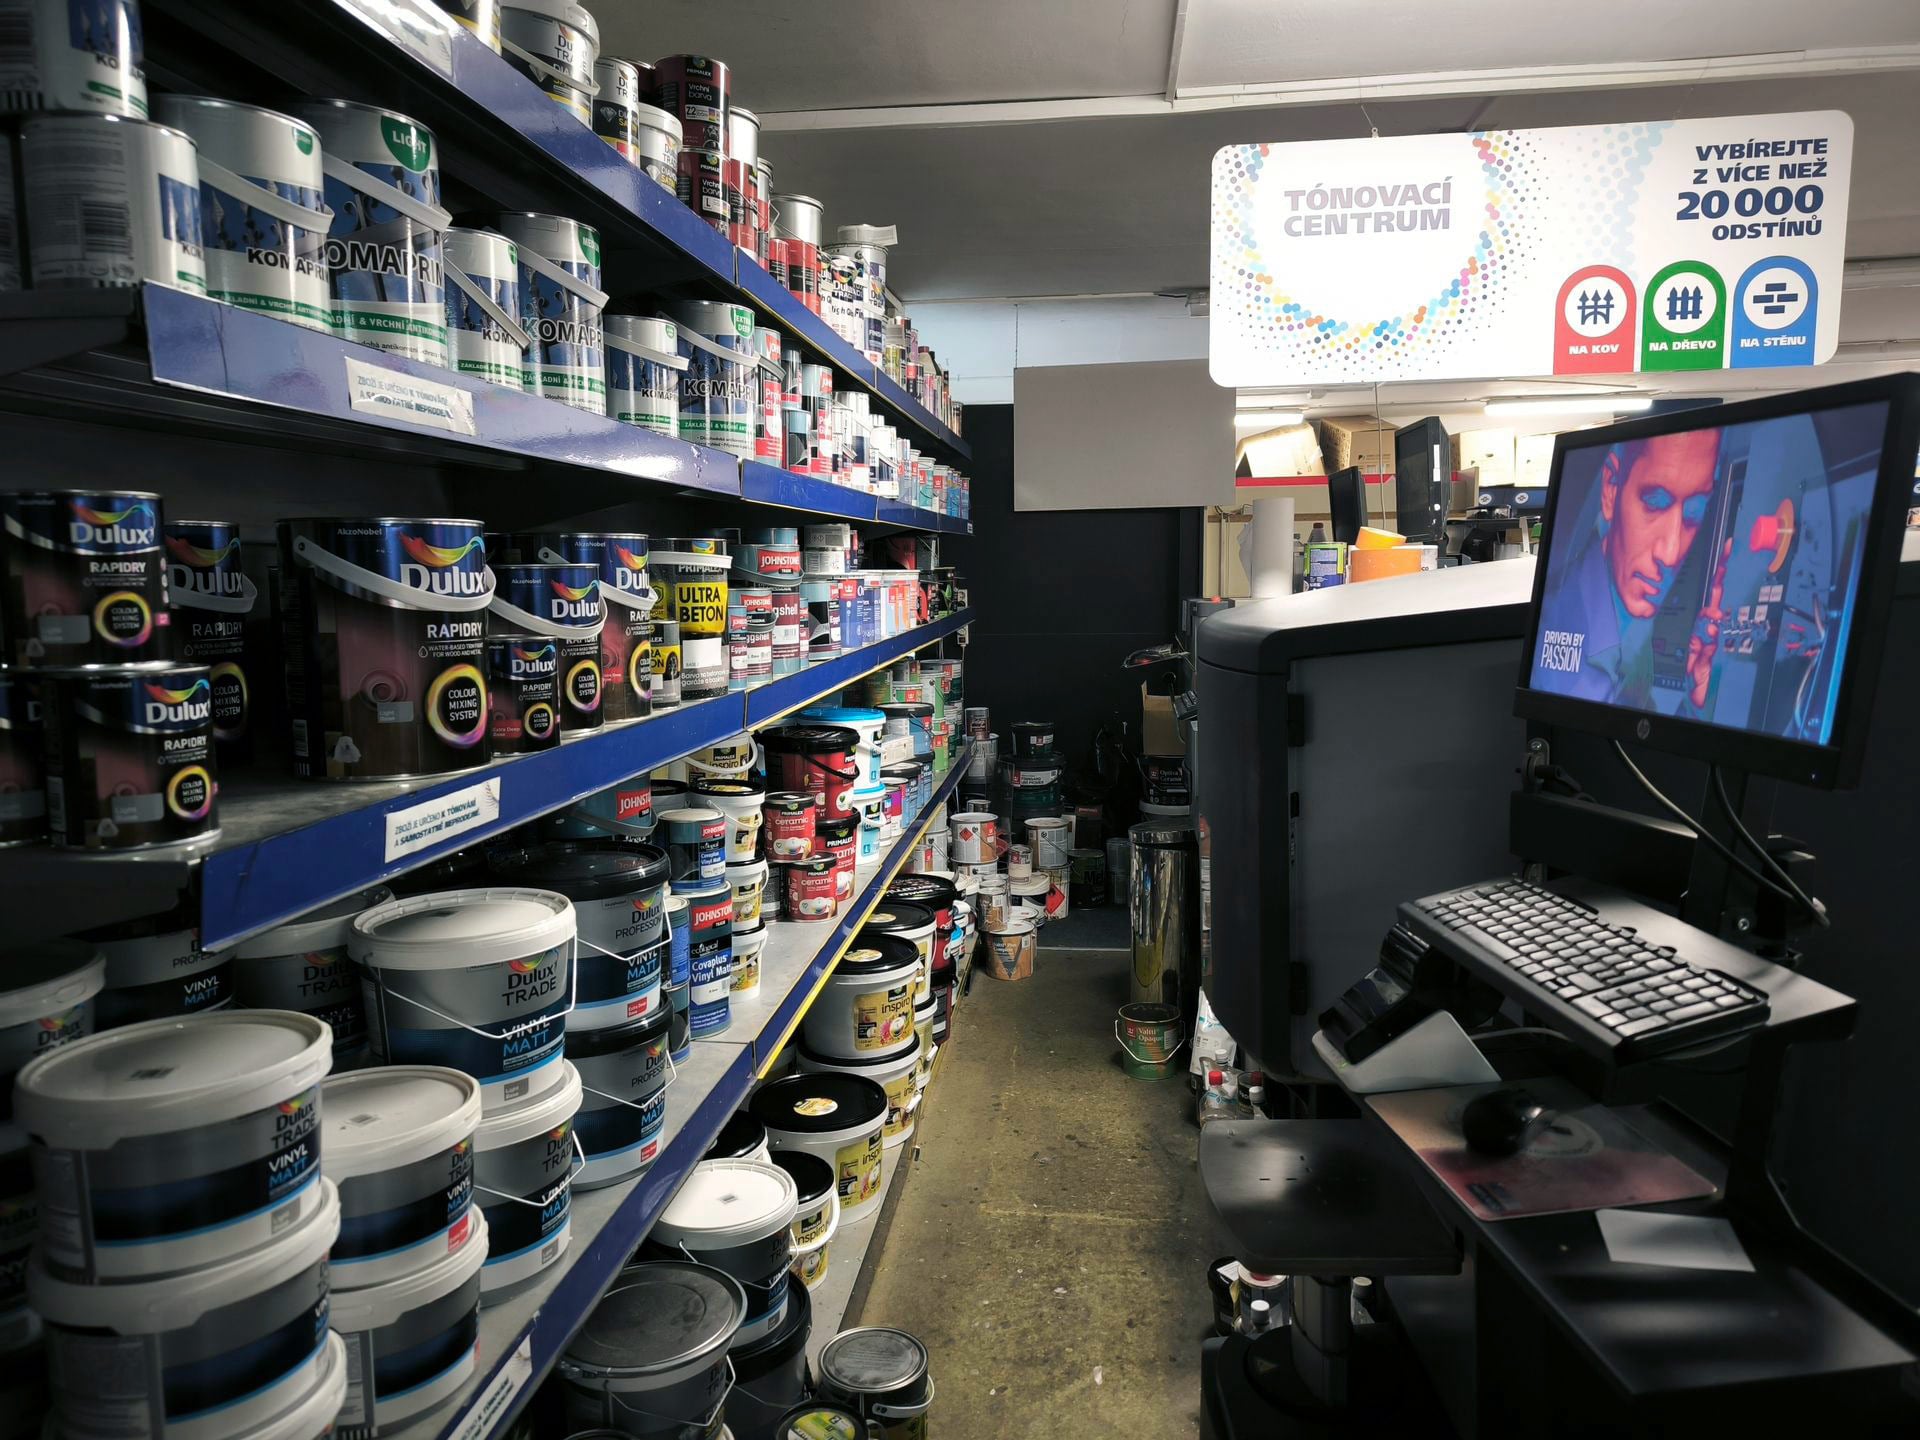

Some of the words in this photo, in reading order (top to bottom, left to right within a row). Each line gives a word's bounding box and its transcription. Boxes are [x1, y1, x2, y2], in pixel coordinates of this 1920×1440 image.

[689, 92, 712, 101] barva
[392, 130, 427, 153] LIGHT
[1695, 138, 1828, 161] VYBÍREJTE
[1693, 168, 1707, 184] Z
[1716, 163, 1770, 183] VÍCE
[1779, 157, 1827, 180] NEŽ
[1284, 176, 1453, 211] TÓNOVACÍ
[1284, 208, 1450, 237] CENTRUM
[1712, 214, 1822, 241] ODSTÍNŮ
[360, 317, 366, 326] &
[370, 318, 404, 330] VRCHNÍ
[1569, 345, 1588, 355] NA
[1592, 343, 1619, 354] KOV
[1649, 342, 1668, 352] NA
[1672, 339, 1717, 351] DŘEVO
[1740, 338, 1760, 348] NA
[1763, 335, 1806, 347] STĚNU
[70, 522, 150, 545] Dulux
[90, 562, 146, 574] RAPIDRY
[171, 564, 243, 594] Dulux
[399, 563, 485, 594] Dulux
[678, 586, 720, 604] ULTRA
[552, 599, 599, 618] Dulux
[679, 606, 724, 622] BETON
[193, 622, 242, 636] RAPIDRY
[427, 622, 482, 638] RAPIDRY
[1544, 630, 1573, 646] DRIVEN
[1573, 634, 1585, 647] BY
[512, 660, 554, 674] Dulux
[1540, 645, 1583, 673] PASSION
[214, 686, 240, 696] COLOUR
[448, 687, 477, 700] COLOUR
[522, 683, 552, 692] RAPIDRY
[214, 695, 240, 706] MIXING
[449, 698, 478, 711] MIXING
[146, 702, 209, 723] Dulux
[215, 706, 241, 717] SYSTEM
[450, 708, 478, 722] SYSTEM
[165, 736, 206, 751] RAPIDRY
[775, 816, 809, 826] ceramic
[394, 839, 400, 848] A
[801, 876, 834, 886] ceramic
[632, 906, 660, 924] Dulux
[628, 950, 658, 967] VINYL
[692, 955, 727, 972] Covaplus
[508, 967, 554, 990] Dulux
[628, 962, 658, 982] MATT
[692, 970, 714, 984] Vinyl
[716, 964, 732, 977] Matt
[184, 975, 220, 994] VINYL
[502, 977, 557, 1006] TRADE
[184, 986, 220, 1006] MATT
[882, 996, 910, 1014] inspiro
[502, 1014, 550, 1041] VINYL
[504, 1030, 548, 1057] MATT
[276, 1103, 314, 1133] Dulux
[271, 1114, 316, 1150] TRADE
[269, 1144, 308, 1173] VINYL
[270, 1157, 309, 1188] MATT
